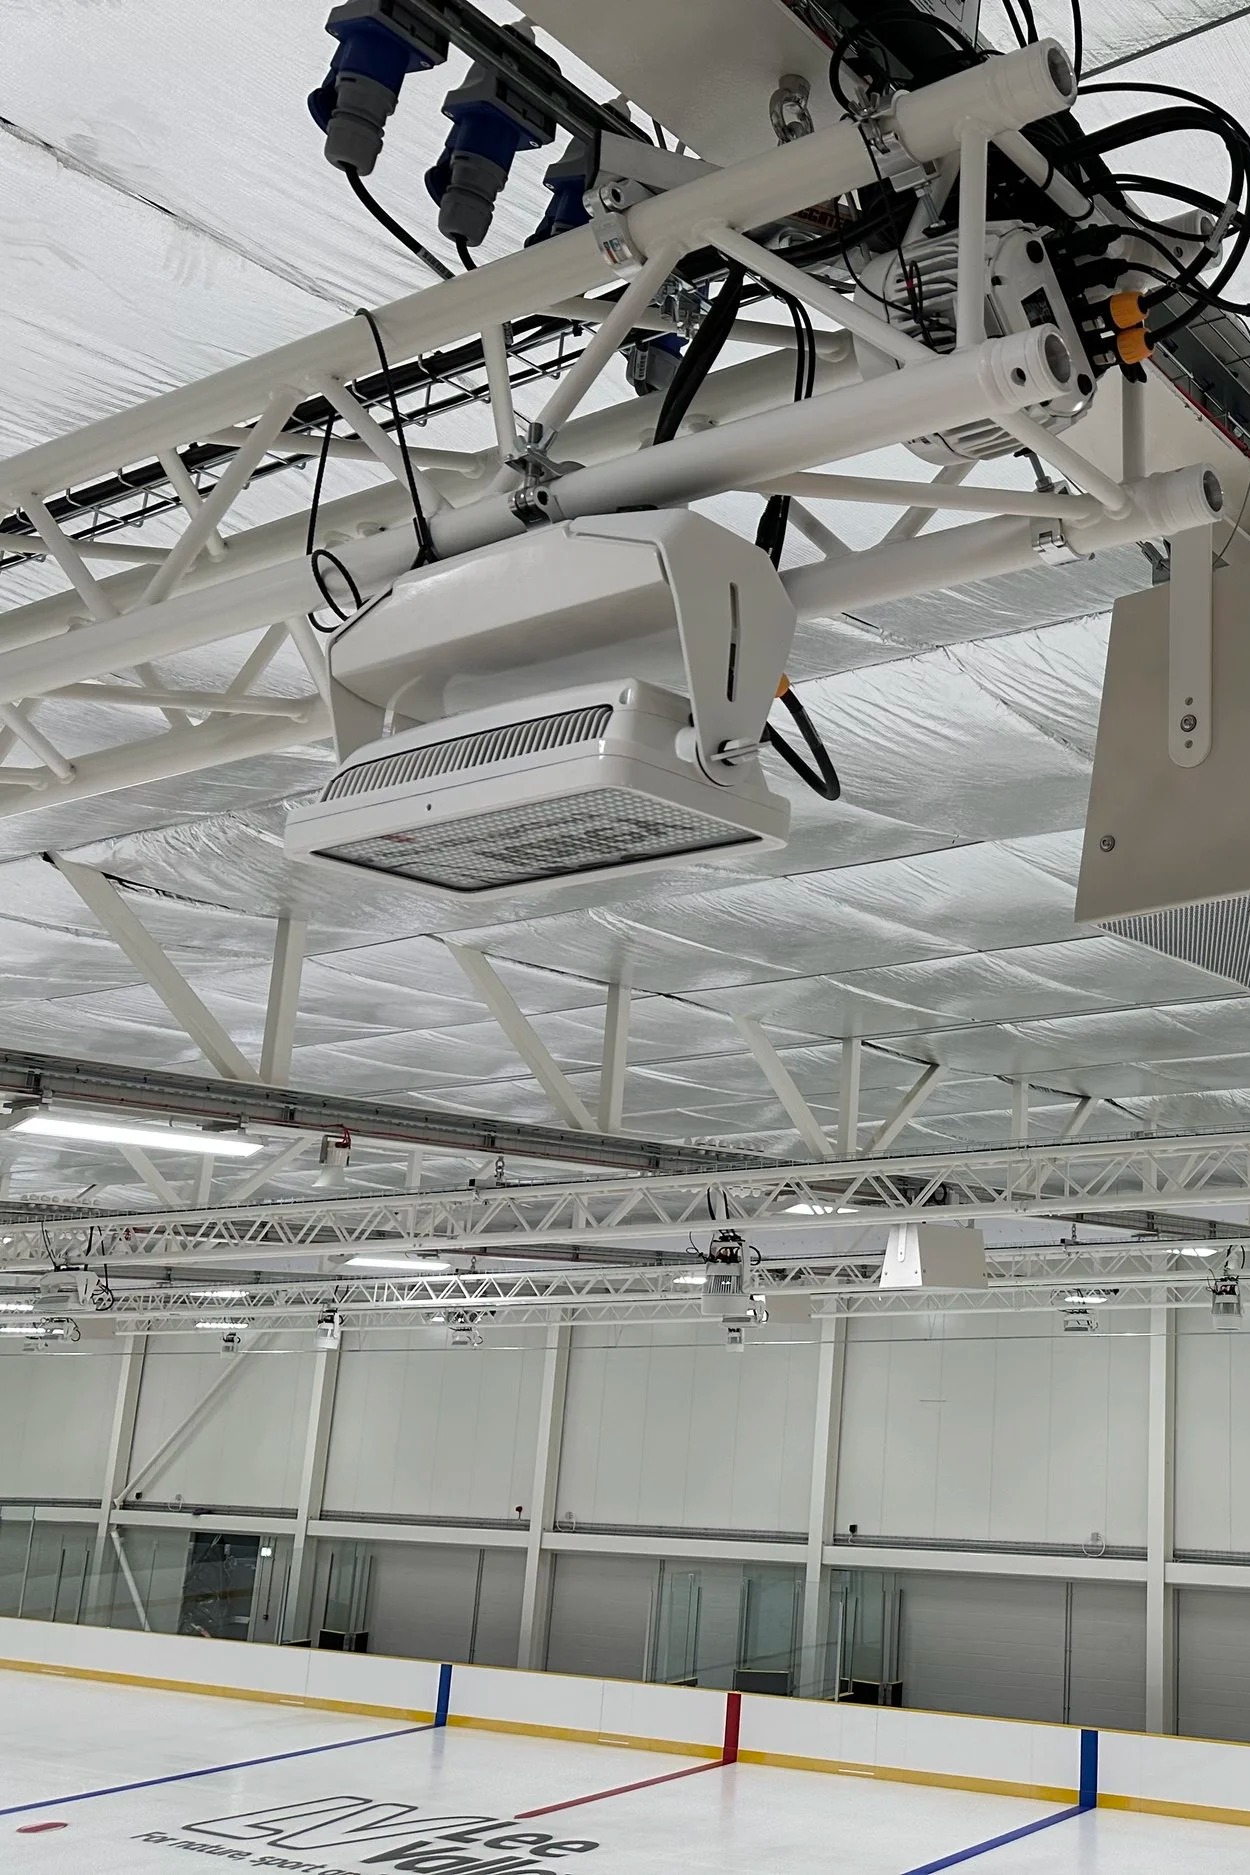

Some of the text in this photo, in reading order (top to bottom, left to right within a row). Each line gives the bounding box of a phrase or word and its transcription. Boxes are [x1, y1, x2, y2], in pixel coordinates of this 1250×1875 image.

[131, 1831, 327, 1873] For nature, sport
[360, 1840, 572, 1875] Vall
[435, 1820, 599, 1858] Lee
